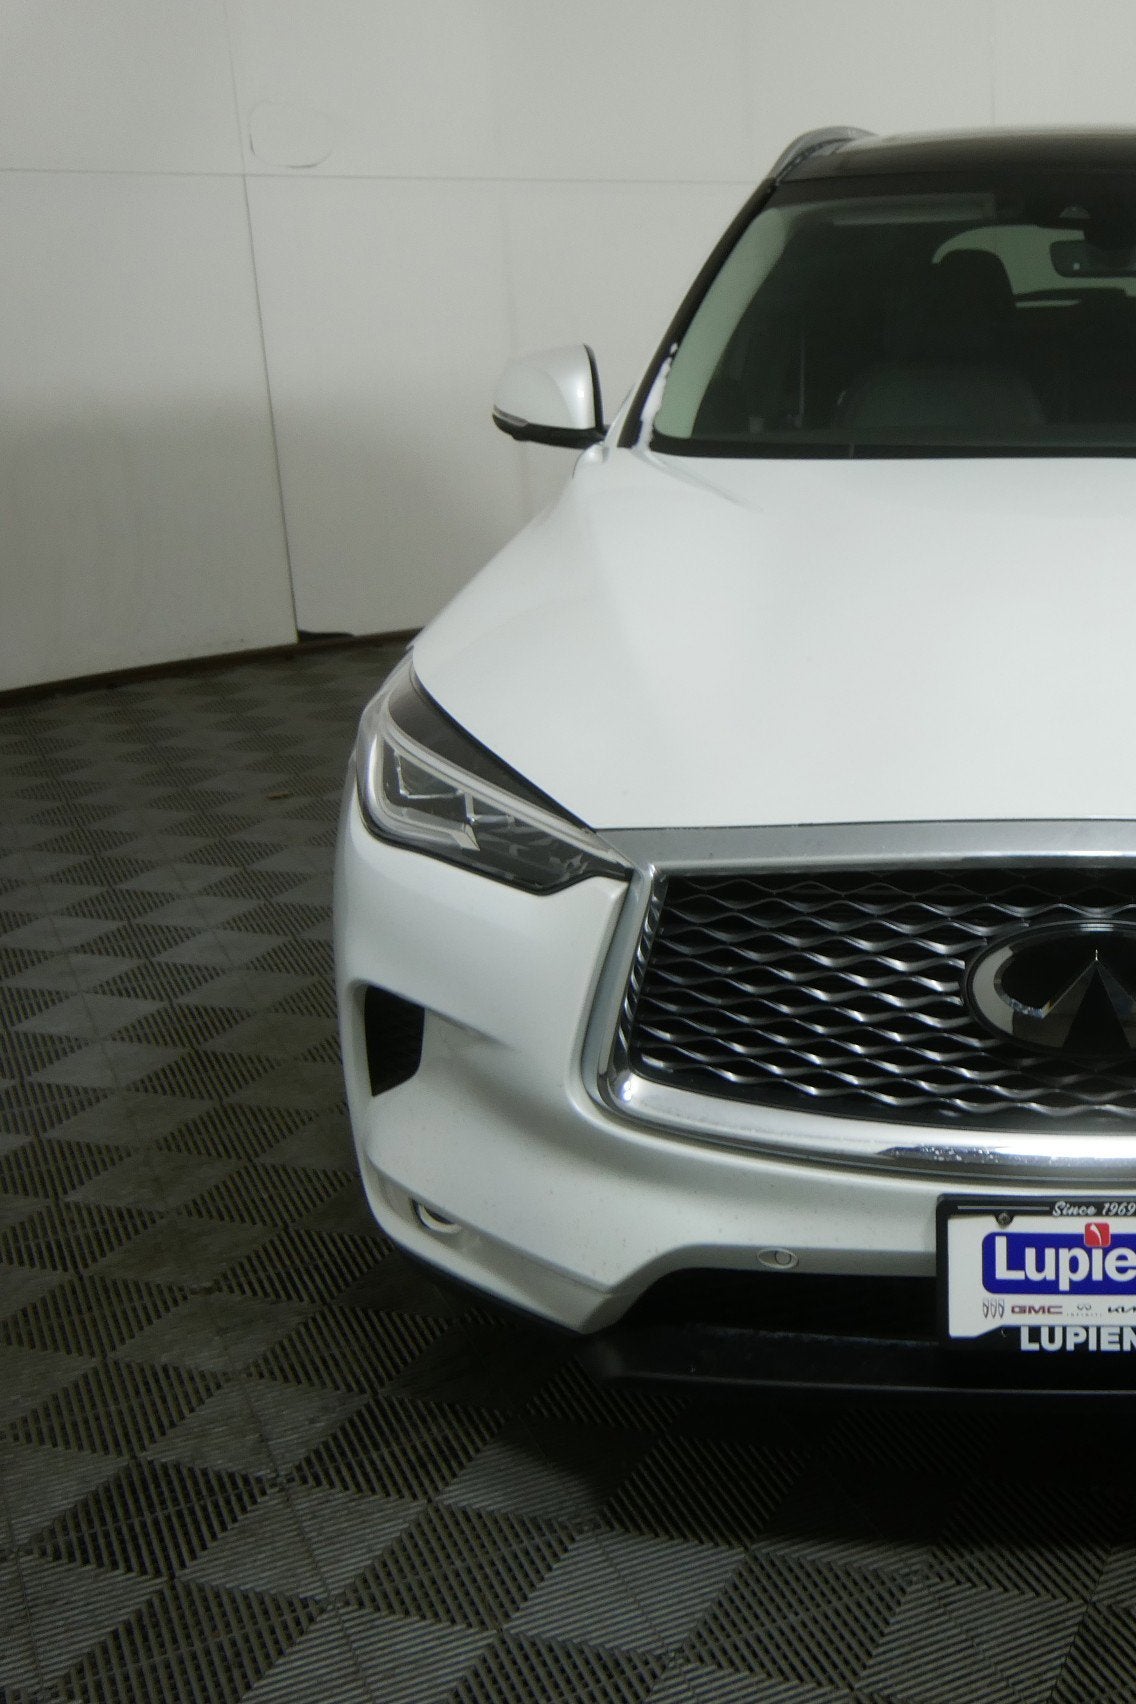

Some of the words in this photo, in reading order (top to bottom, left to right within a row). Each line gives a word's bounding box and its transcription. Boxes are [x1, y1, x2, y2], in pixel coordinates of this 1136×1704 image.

[1053, 1200, 1097, 1217] Since
[1102, 1201, 1136, 1217] 1969
[1011, 1304, 1063, 1315] GMC
